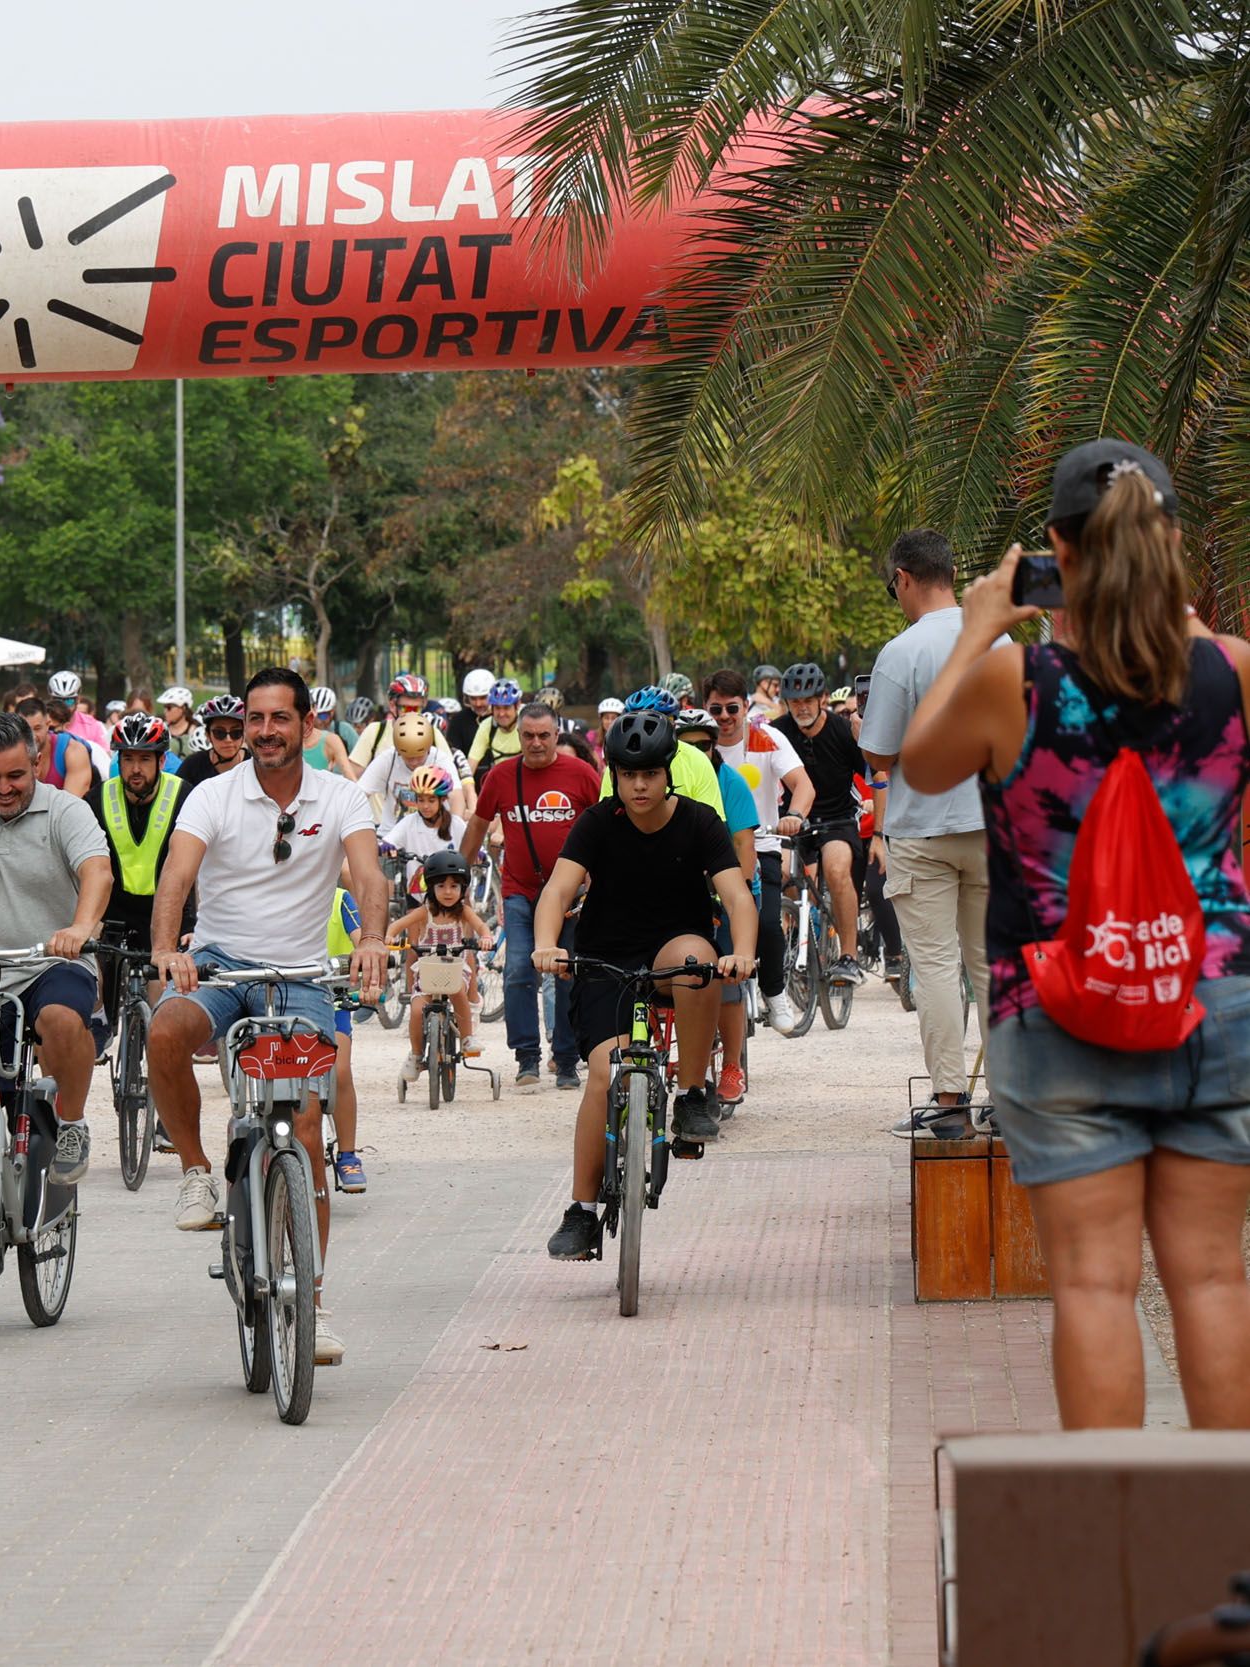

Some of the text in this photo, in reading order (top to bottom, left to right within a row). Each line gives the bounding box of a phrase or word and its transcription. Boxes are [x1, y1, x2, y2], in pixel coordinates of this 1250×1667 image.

[218, 153, 606, 228] MISLATA
[207, 232, 513, 309] CIUTAT
[197, 304, 671, 365] ESPORTIVA
[507, 805, 576, 822] ellesse
[1144, 934, 1191, 970] Bici
